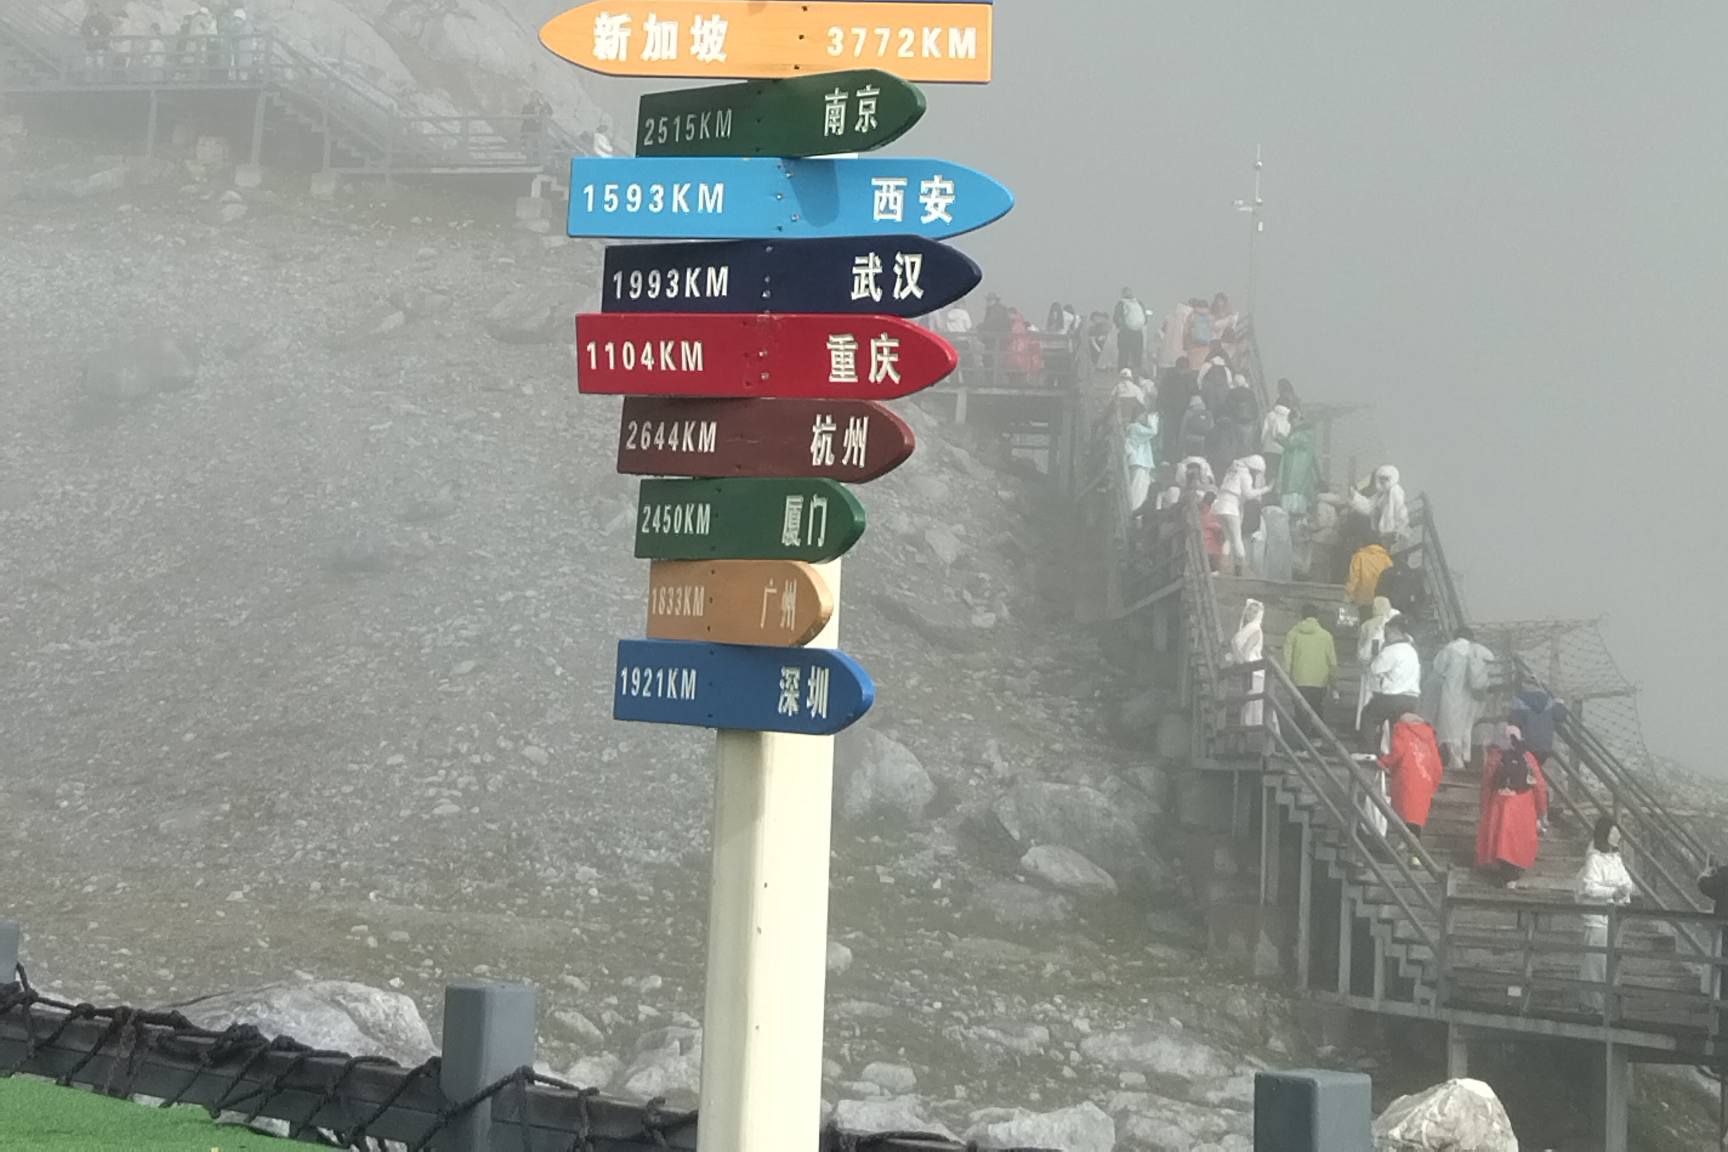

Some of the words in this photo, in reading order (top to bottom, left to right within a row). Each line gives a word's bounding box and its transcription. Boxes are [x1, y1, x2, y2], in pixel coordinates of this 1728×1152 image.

[593, 12, 728, 62] 新加坡
[827, 27, 976, 59] 3772KM
[644, 109, 733, 146] 2515KM
[824, 84, 880, 137] 南京
[583, 183, 725, 213] 1593KM
[871, 175, 956, 224] 西安
[613, 266, 728, 299] 1993KM
[851, 252, 924, 302] 武汉
[586, 340, 704, 371] 1104KM
[826, 333, 901, 383] 重庆
[626, 420, 717, 453] 2644KM
[810, 414, 869, 468] 杭州
[641, 504, 711, 535] 2450KM
[781, 495, 828, 547] 厦门
[652, 585, 705, 616] 1833KM
[760, 578, 797, 631] 广州
[620, 667, 697, 700] 1921KM
[778, 665, 830, 719] 深圳
